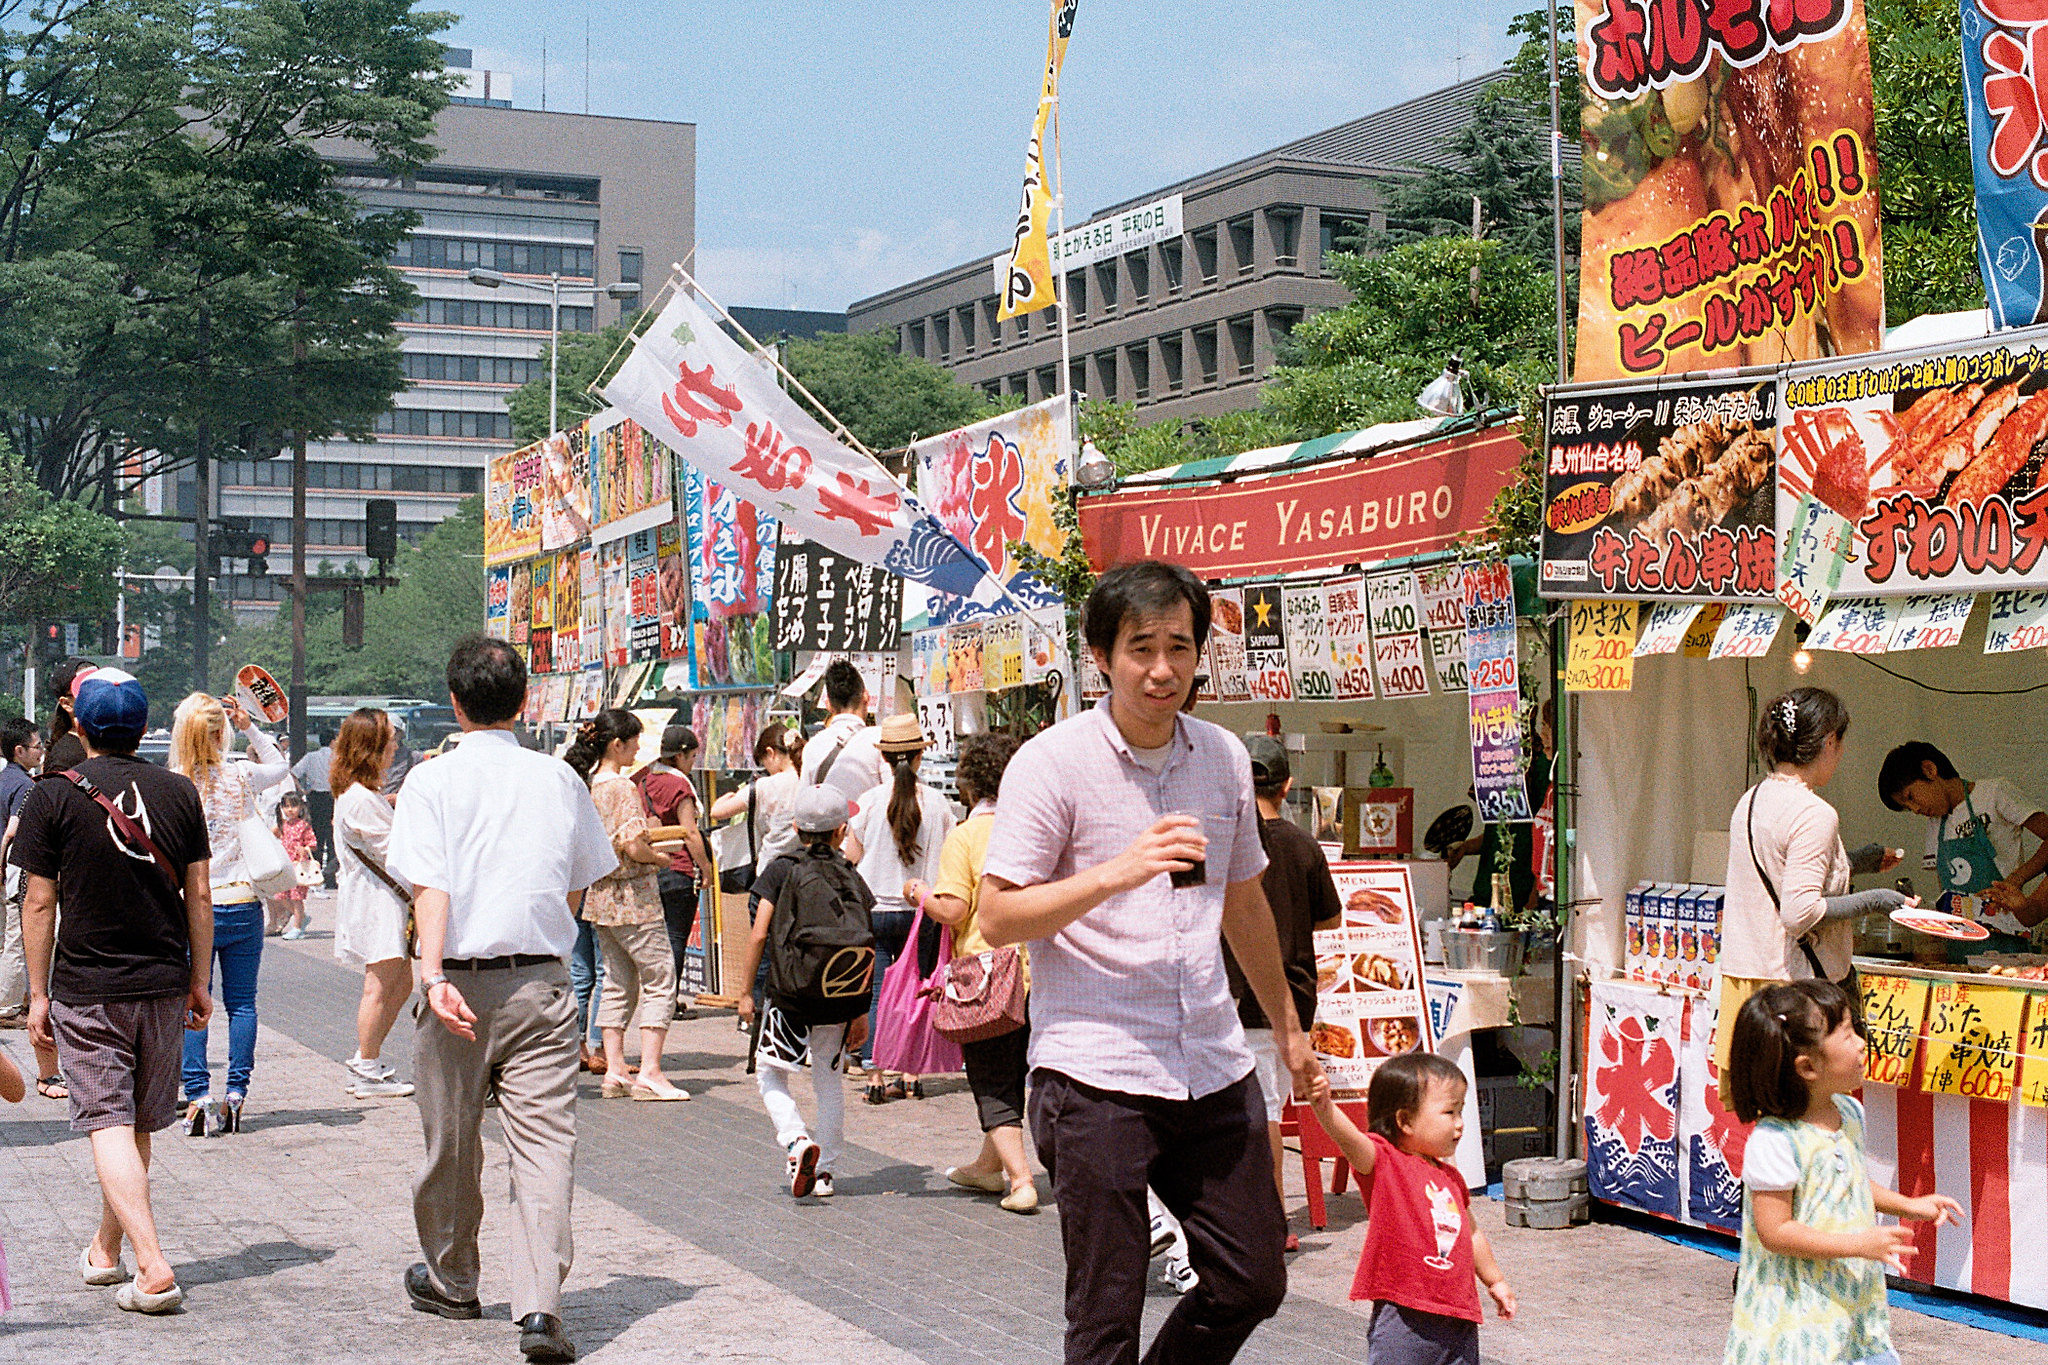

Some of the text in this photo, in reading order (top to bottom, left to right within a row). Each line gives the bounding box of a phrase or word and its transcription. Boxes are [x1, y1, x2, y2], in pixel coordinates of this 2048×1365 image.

[1121, 206, 1164, 237] 平和の日
[1551, 405, 1582, 436] 肉厚
[660, 359, 903, 538] かき氷
[1549, 441, 1643, 475] 奥州仙台名物
[1140, 485, 1453, 556] VIVACE YASABURO
[816, 557, 836, 650] 玉子
[1373, 604, 1416, 633] ¥400
[1468, 602, 1513, 629] あります!
[1573, 602, 1632, 637] かき氷
[1249, 634, 1280, 647] SAPPORO
[1246, 651, 1287, 671] 黒ラベル
[1439, 660, 1468, 687] ¥40
[1470, 657, 1515, 689] ¥250
[1249, 669, 1292, 700] ¥450
[1296, 669, 1332, 695] ¥500
[1335, 667, 1371, 694] ¥450
[1381, 665, 1425, 693] ¥400
[1339, 876, 1376, 886] MENU
[1861, 975, 1911, 996] 台発祥
[1935, 985, 1971, 1006] 国産
[1930, 1003, 1983, 1037] ぶた
[1950, 1030, 2015, 1069] 串焼
[1595, 1015, 1676, 1155] 氷
[1958, 1066, 2013, 1100] 600円
